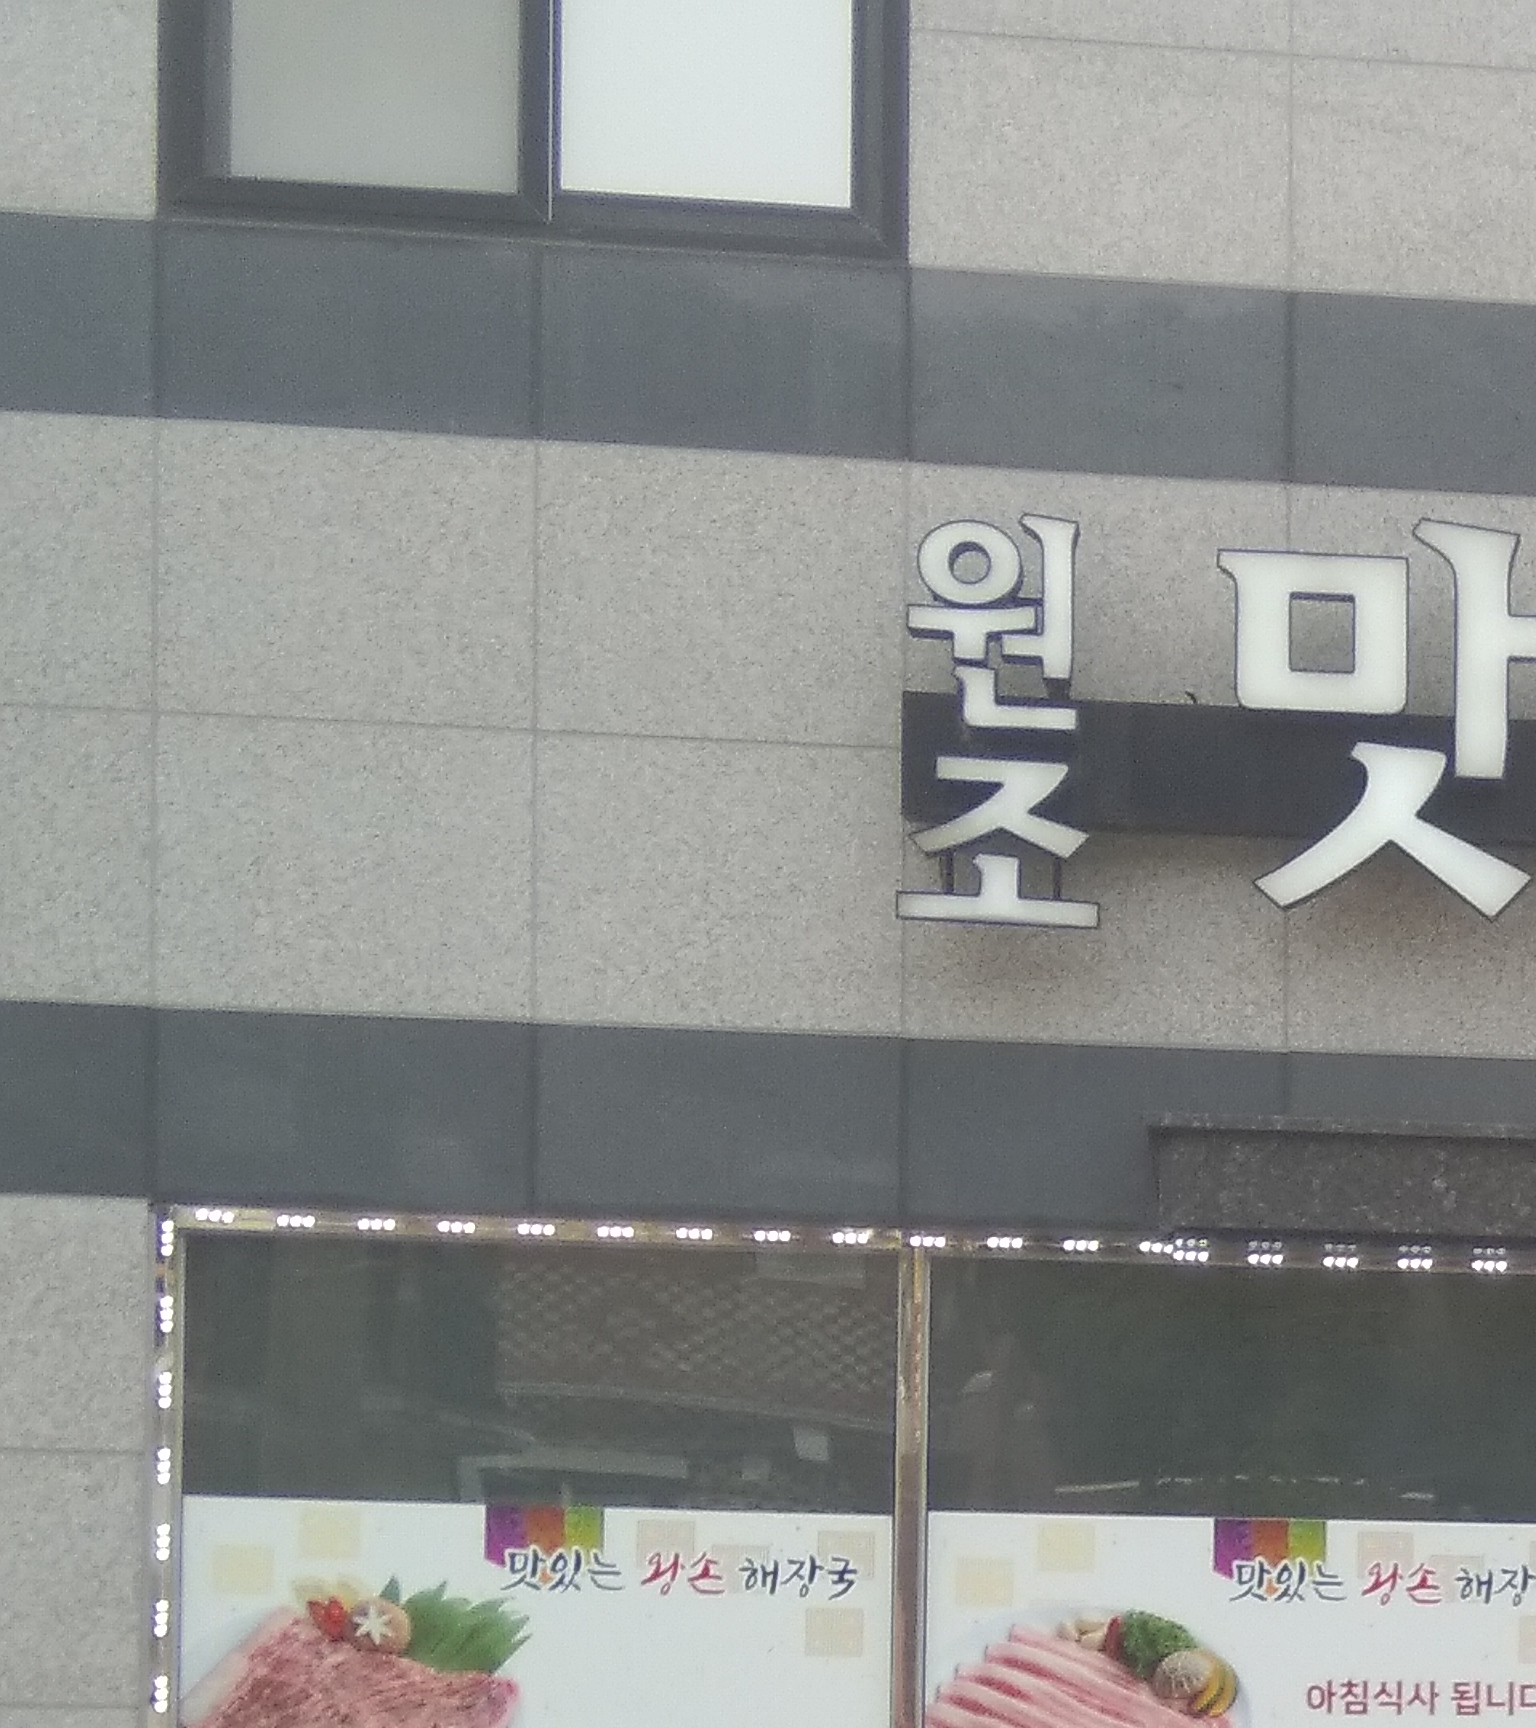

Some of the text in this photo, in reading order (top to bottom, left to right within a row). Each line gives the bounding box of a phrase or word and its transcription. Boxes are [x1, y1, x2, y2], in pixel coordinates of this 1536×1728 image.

[896, 513, 1100, 929] 원조
[500, 1548, 858, 1599] 맛있는 왕손 해장국
[1230, 1558, 1348, 1603] 맛있는
[1361, 1561, 1444, 1607] 왕손
[1306, 1680, 1440, 1716] 아침식사
